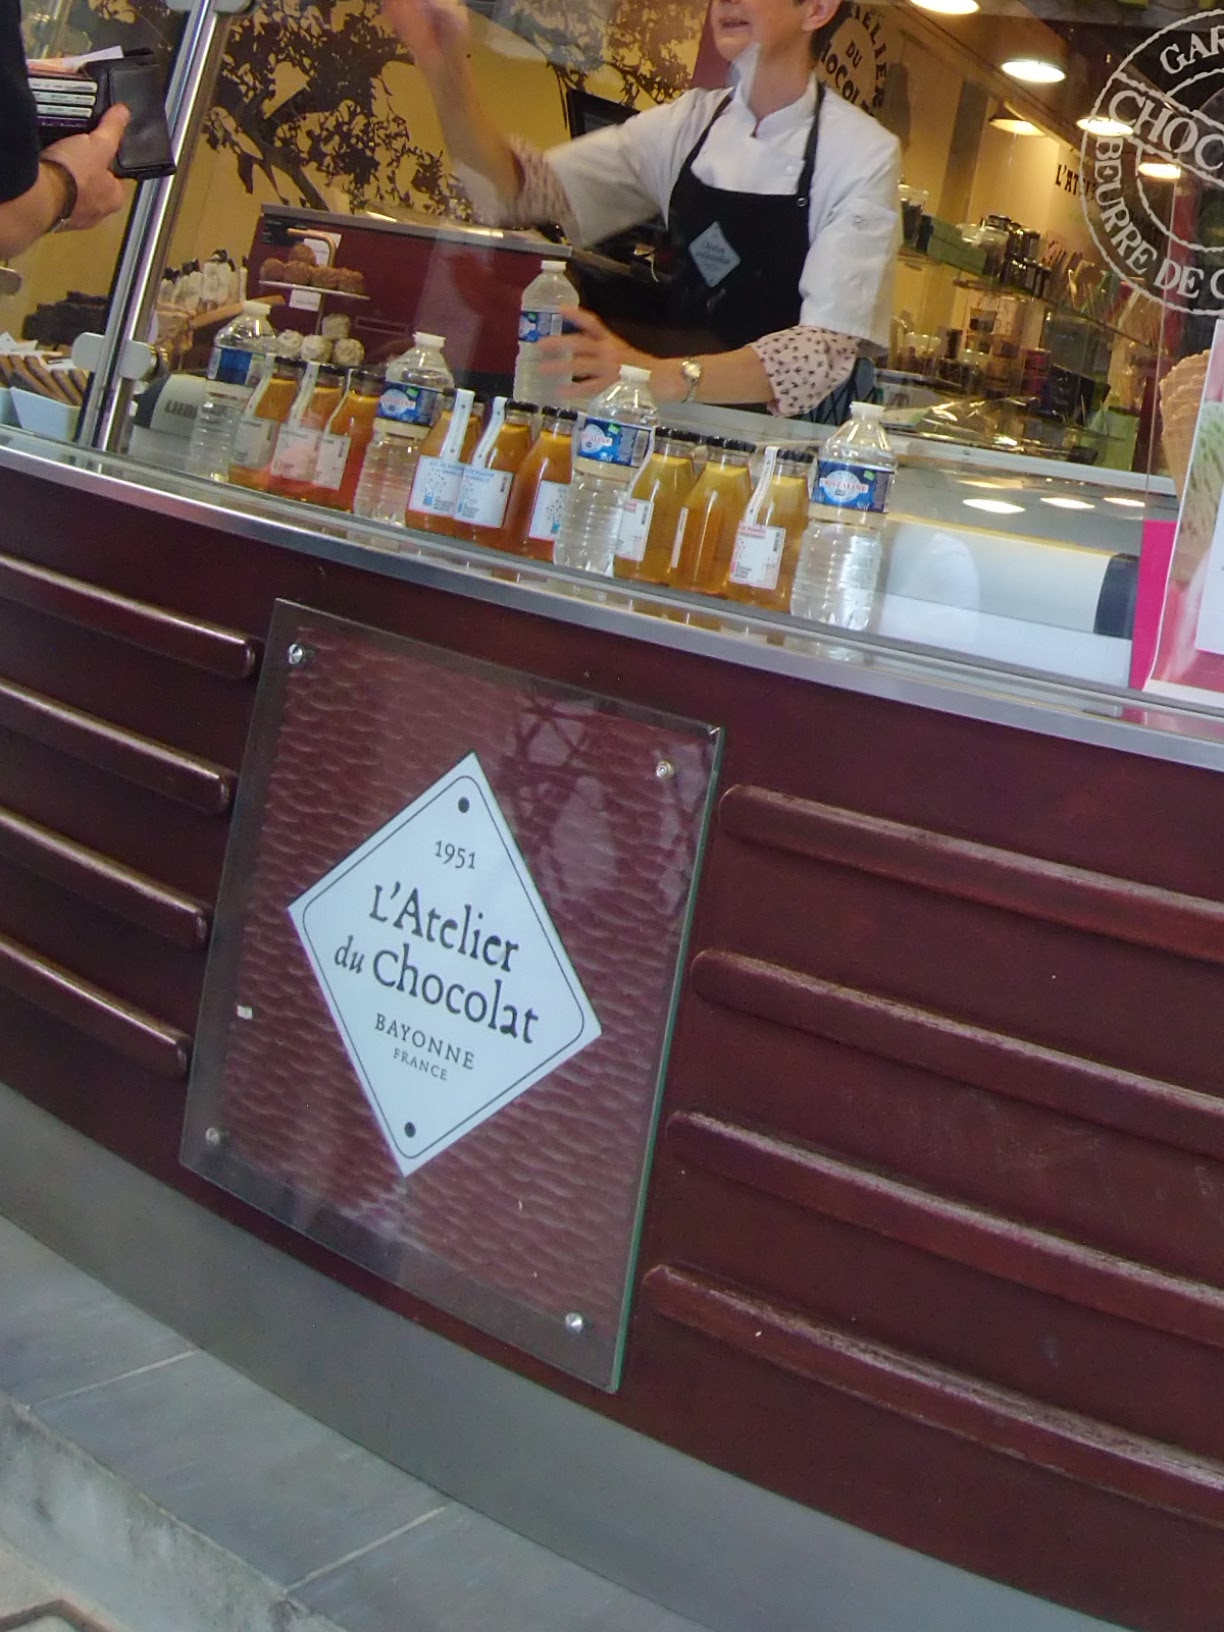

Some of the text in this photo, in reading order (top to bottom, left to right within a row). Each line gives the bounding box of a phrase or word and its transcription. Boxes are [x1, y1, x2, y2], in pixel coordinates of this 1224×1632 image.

[845, 38, 864, 69] DU
[1094, 137, 1158, 276] BEURRE
[1154, 259, 1205, 300] DE
[434, 840, 476, 870] 1951
[368, 881, 520, 973] L'Atelier
[334, 934, 540, 1044] du Chocolat
[374, 1012, 476, 1070] BAYONNE
[392, 1048, 448, 1081] FRANCE
